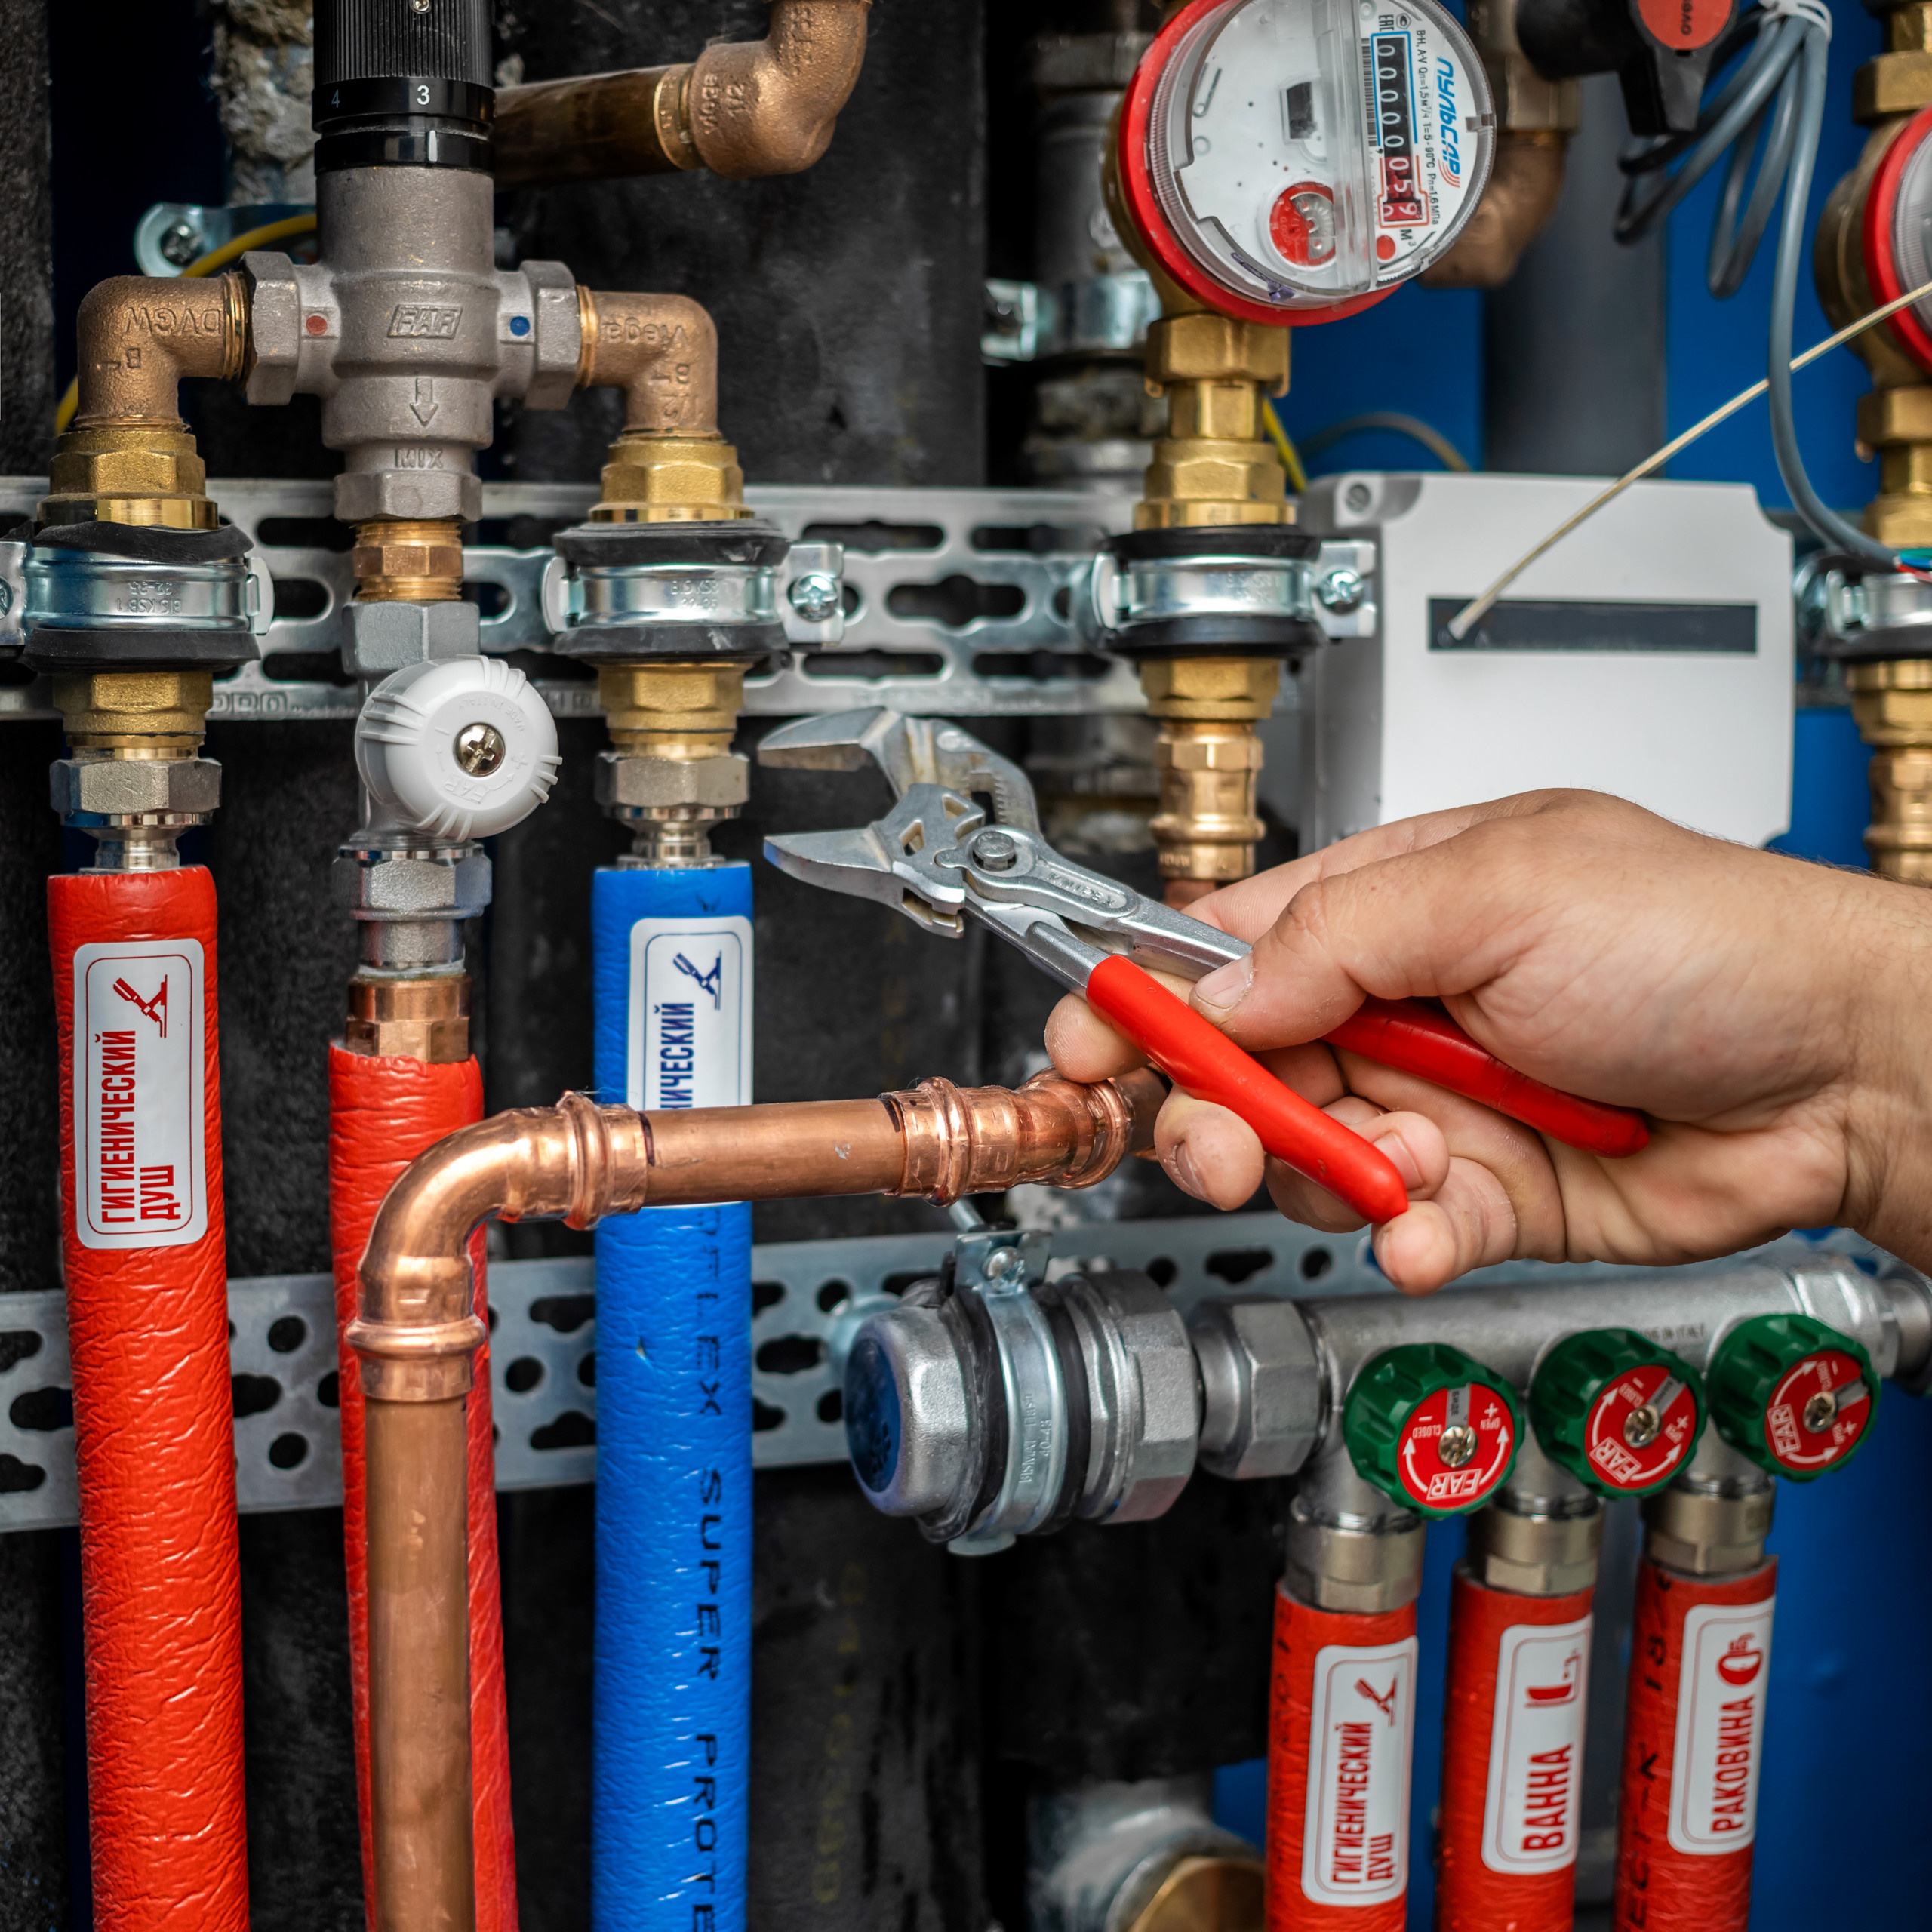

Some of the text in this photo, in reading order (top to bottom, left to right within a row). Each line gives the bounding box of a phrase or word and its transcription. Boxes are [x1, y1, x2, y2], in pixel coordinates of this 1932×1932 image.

[331, 85, 430, 108] 4 3
[1437, 57, 1460, 175] ПУЛЬСАР
[123, 306, 222, 337] DVGW
[394, 307, 457, 337] FAR
[600, 316, 690, 352] Viega
[395, 448, 444, 469] MIX
[1047, 870, 1115, 907] KNIPEX
[94, 1030, 137, 1223] ГИГИЕНИЧЕСКИЙ
[140, 1164, 181, 1220] ДУШ
[1412, 1423, 1442, 1439] CLOSED
[1480, 1416, 1503, 1431] OPEN
[1769, 1405, 1801, 1455] FAR
[1592, 1438, 1640, 1482] FAR
[1429, 1470, 1481, 1499] FAR
[697, 1468, 721, 1680] SUPER
[1709, 1692, 1755, 1834] РАКОВИНА
[1331, 1721, 1374, 1884] ГИГИЕНИЧЕСКИЙ
[1521, 1742, 1573, 1853] ВАННА
[1367, 1832, 1397, 1881] ДУШ
